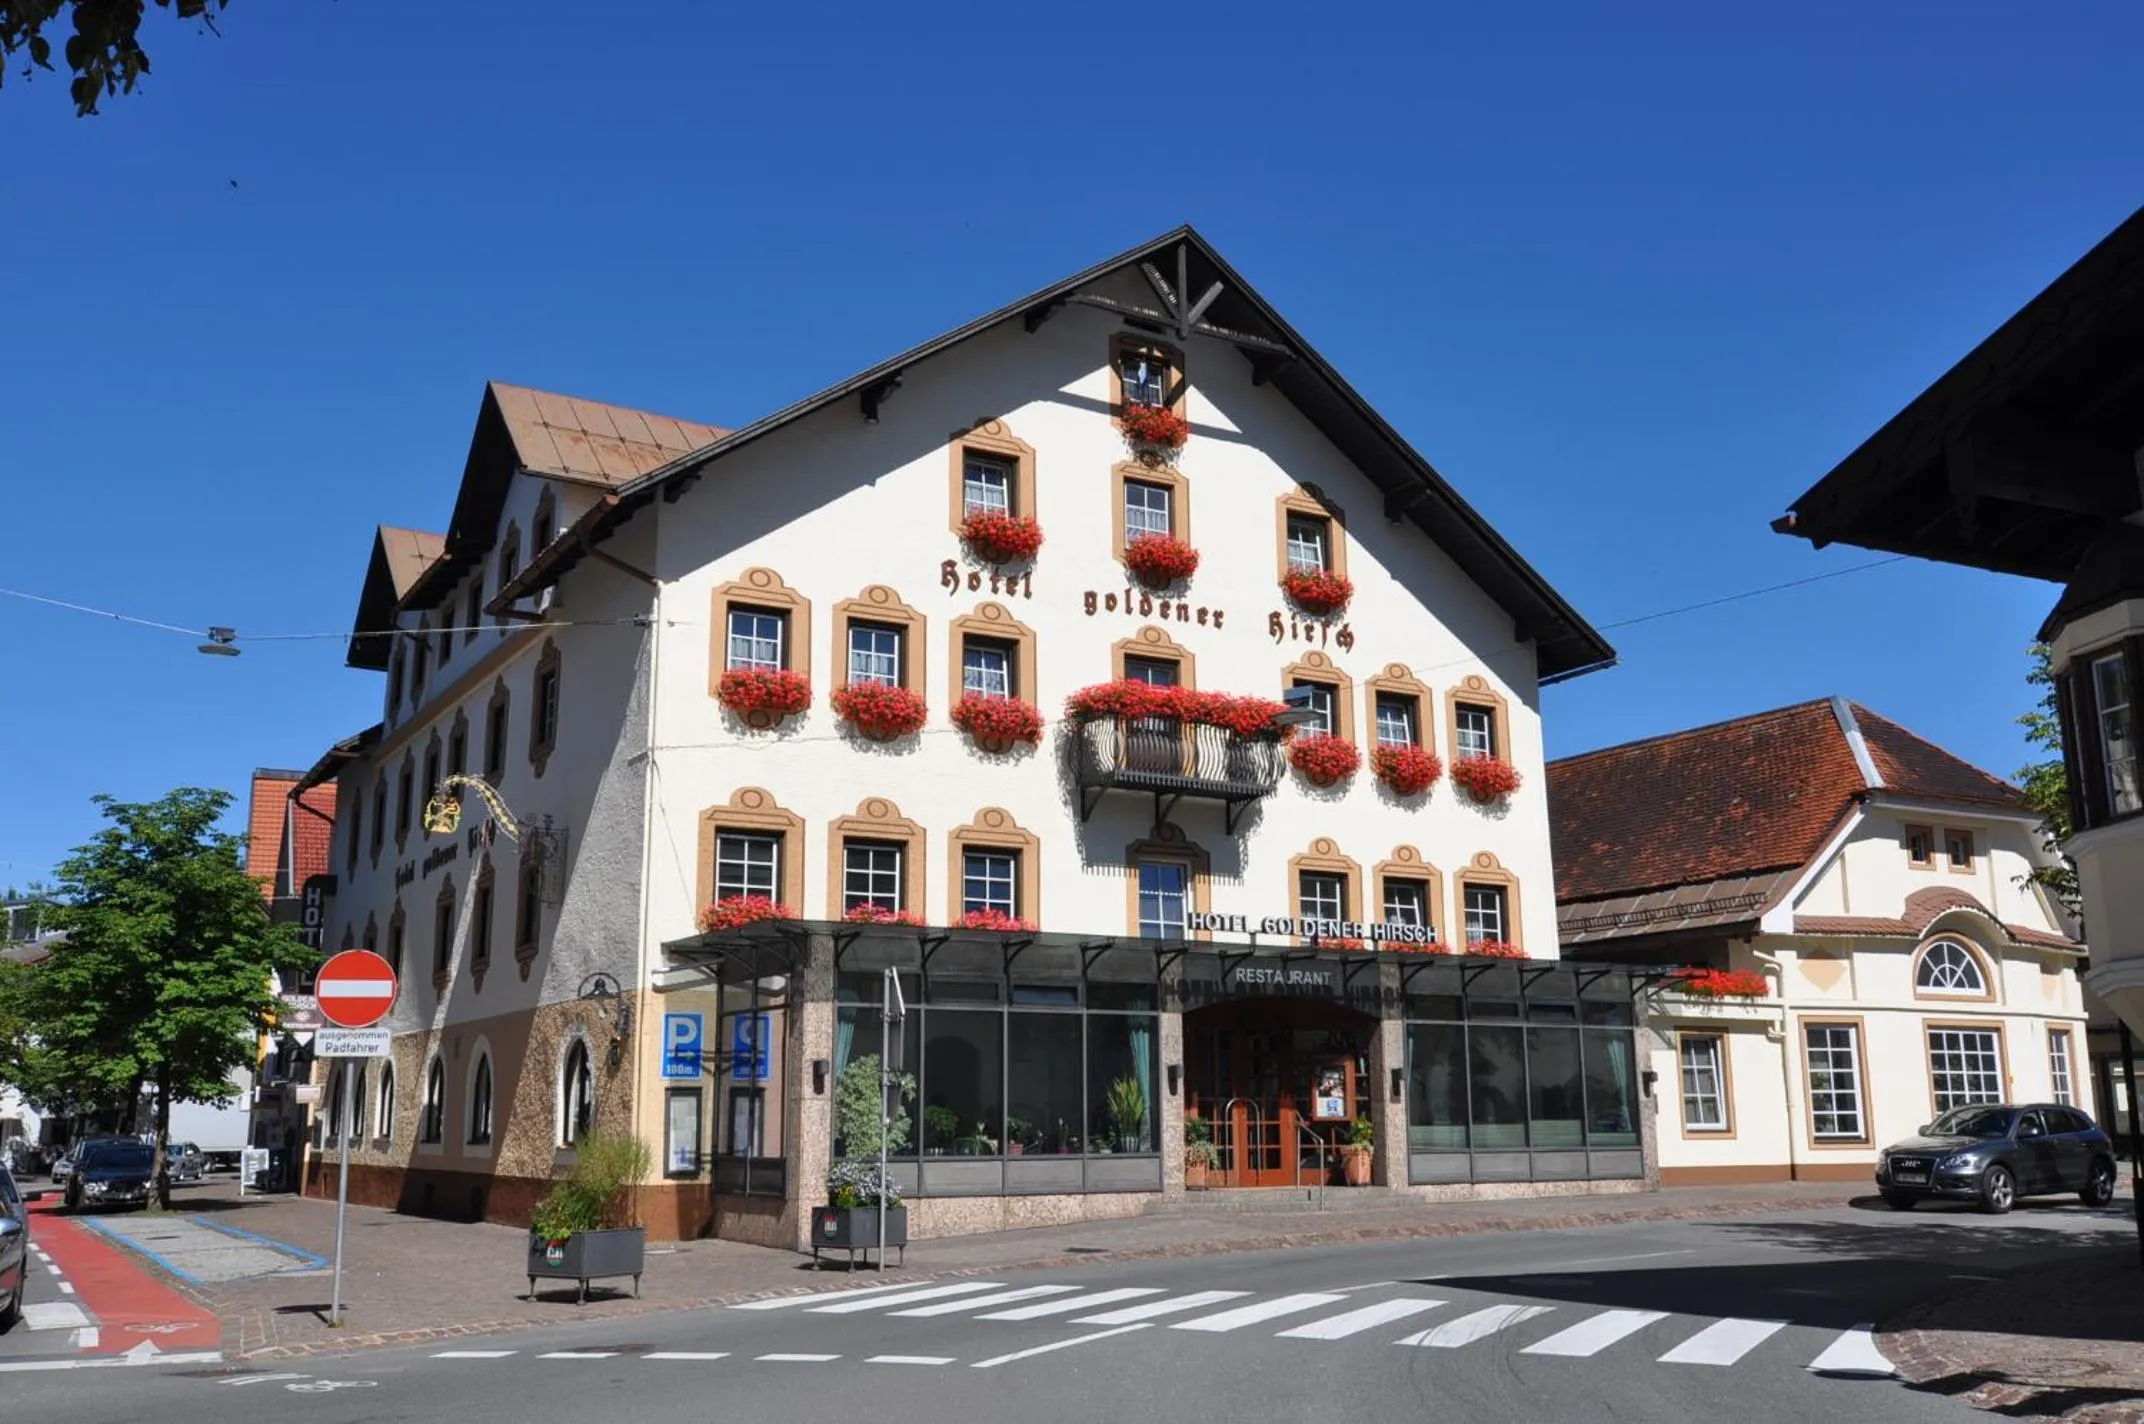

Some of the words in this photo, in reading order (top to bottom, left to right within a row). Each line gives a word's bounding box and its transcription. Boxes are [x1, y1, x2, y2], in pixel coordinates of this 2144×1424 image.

[941, 559, 1032, 600] Hotel
[1084, 587, 1224, 629] goldener
[301, 887, 321, 986] HOTL
[1190, 911, 1252, 933] HOTEL
[1262, 916, 1364, 939] GOLDENER
[1373, 922, 1439, 944] HIRSCH
[1236, 967, 1331, 986] RESTAURANT
[668, 1017, 698, 1054] P
